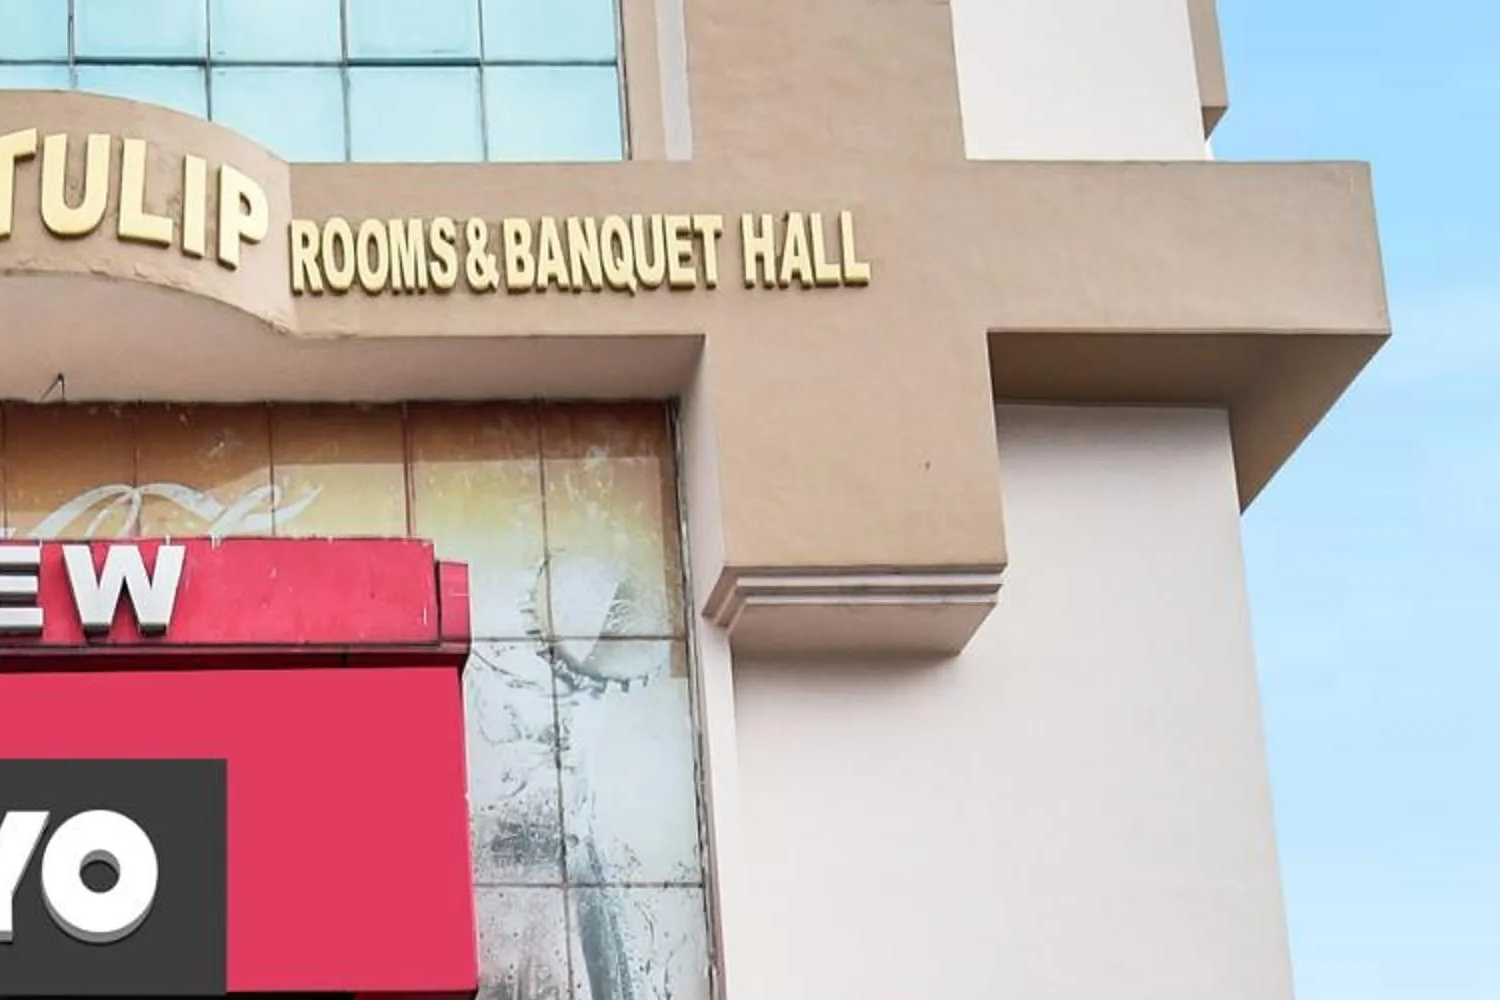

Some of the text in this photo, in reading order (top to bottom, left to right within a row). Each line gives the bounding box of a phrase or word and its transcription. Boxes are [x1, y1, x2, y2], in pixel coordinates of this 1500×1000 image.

[289, 216, 458, 292] ROOMS
[503, 213, 723, 293] BANQUET
[742, 210, 871, 288] HALL
